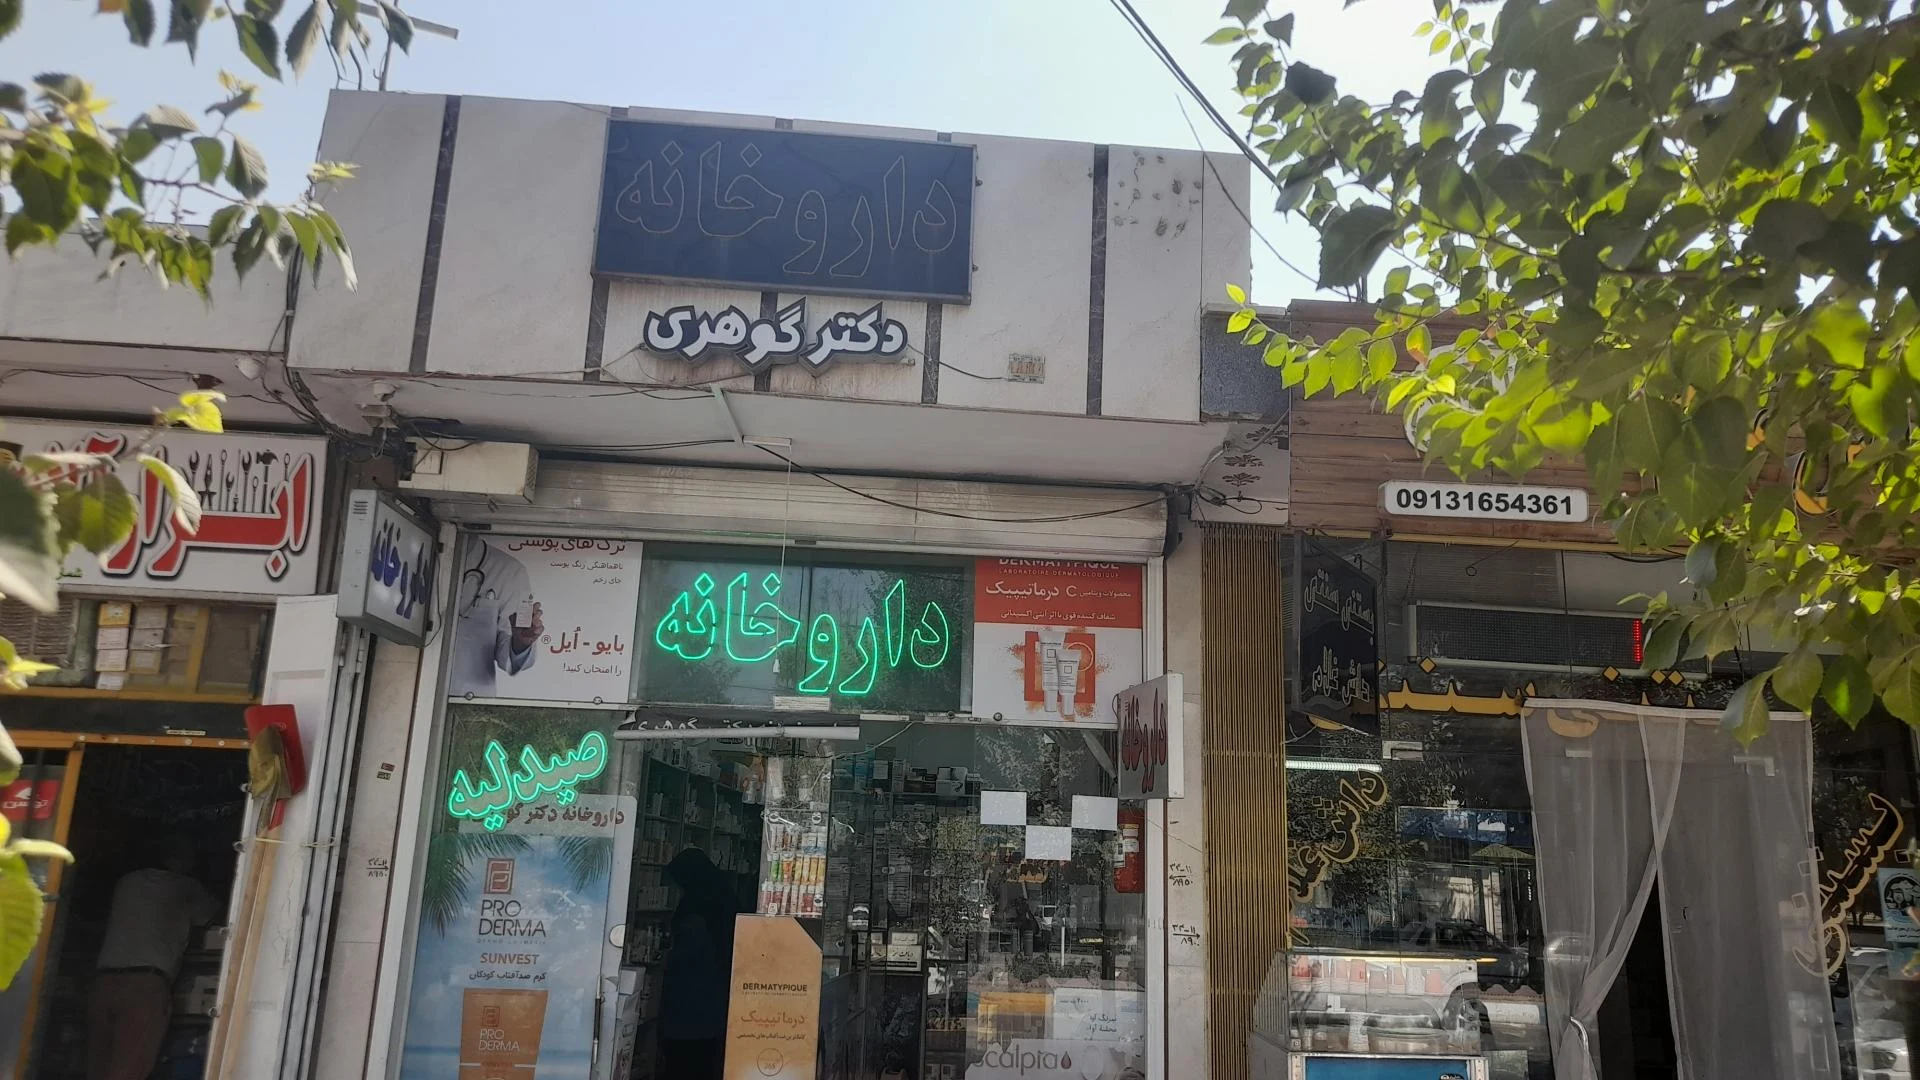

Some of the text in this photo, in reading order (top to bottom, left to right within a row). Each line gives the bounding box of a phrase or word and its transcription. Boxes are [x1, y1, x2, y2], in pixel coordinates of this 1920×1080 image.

[615, 140, 957, 278] داروخانه
[644, 297, 908, 374] دکتر گوهری
[1396, 488, 1572, 515] 09131654361
[371, 519, 433, 620] داروخانه
[985, 581, 1060, 601] درماتیپیک
[1066, 585, 1078, 597] C
[1304, 568, 1375, 646] بستنی سنتی
[655, 572, 950, 694] داروخانه
[592, 634, 625, 656] بایو
[1121, 687, 1168, 794] داروخانه
[449, 731, 608, 830] صیدلیه
[524, 804, 558, 824] دکتر
[562, 805, 625, 827] داروخانه
[480, 899, 522, 918] PRO
[478, 918, 547, 937] DERMA
[480, 952, 540, 965] SUNVEST
[469, 970, 495, 980] کودکان
[533, 972, 548, 983] کرم
[742, 982, 808, 992] DERMATYPIQUE
[740, 1010, 805, 1028] درماتیپیک
[480, 1028, 505, 1040] PRO
[478, 1039, 520, 1052] DERMA
